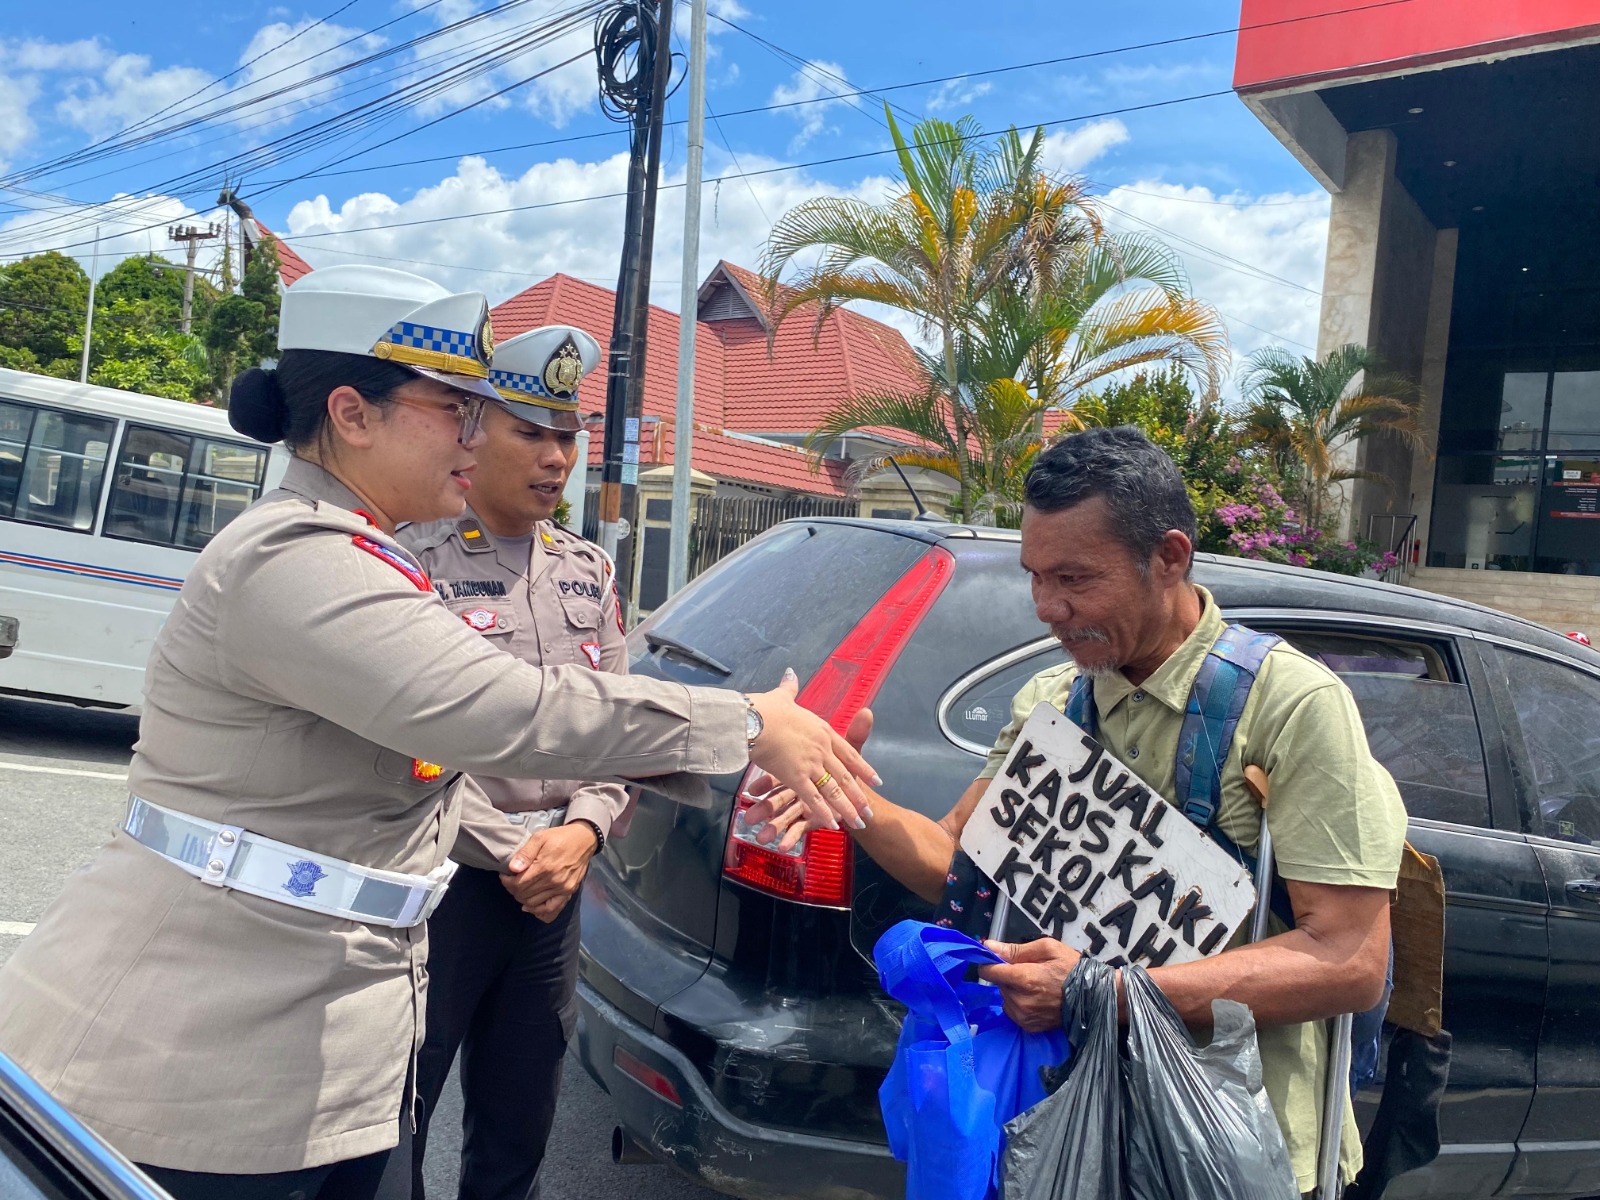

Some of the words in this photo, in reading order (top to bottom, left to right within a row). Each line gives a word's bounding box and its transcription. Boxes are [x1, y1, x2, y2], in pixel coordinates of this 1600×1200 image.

[990, 789, 1178, 969] SEKOLAH
[1005, 740, 1116, 853] KAOS
[1108, 839, 1229, 956] KAKI
[1069, 735, 1167, 848] JUAL
